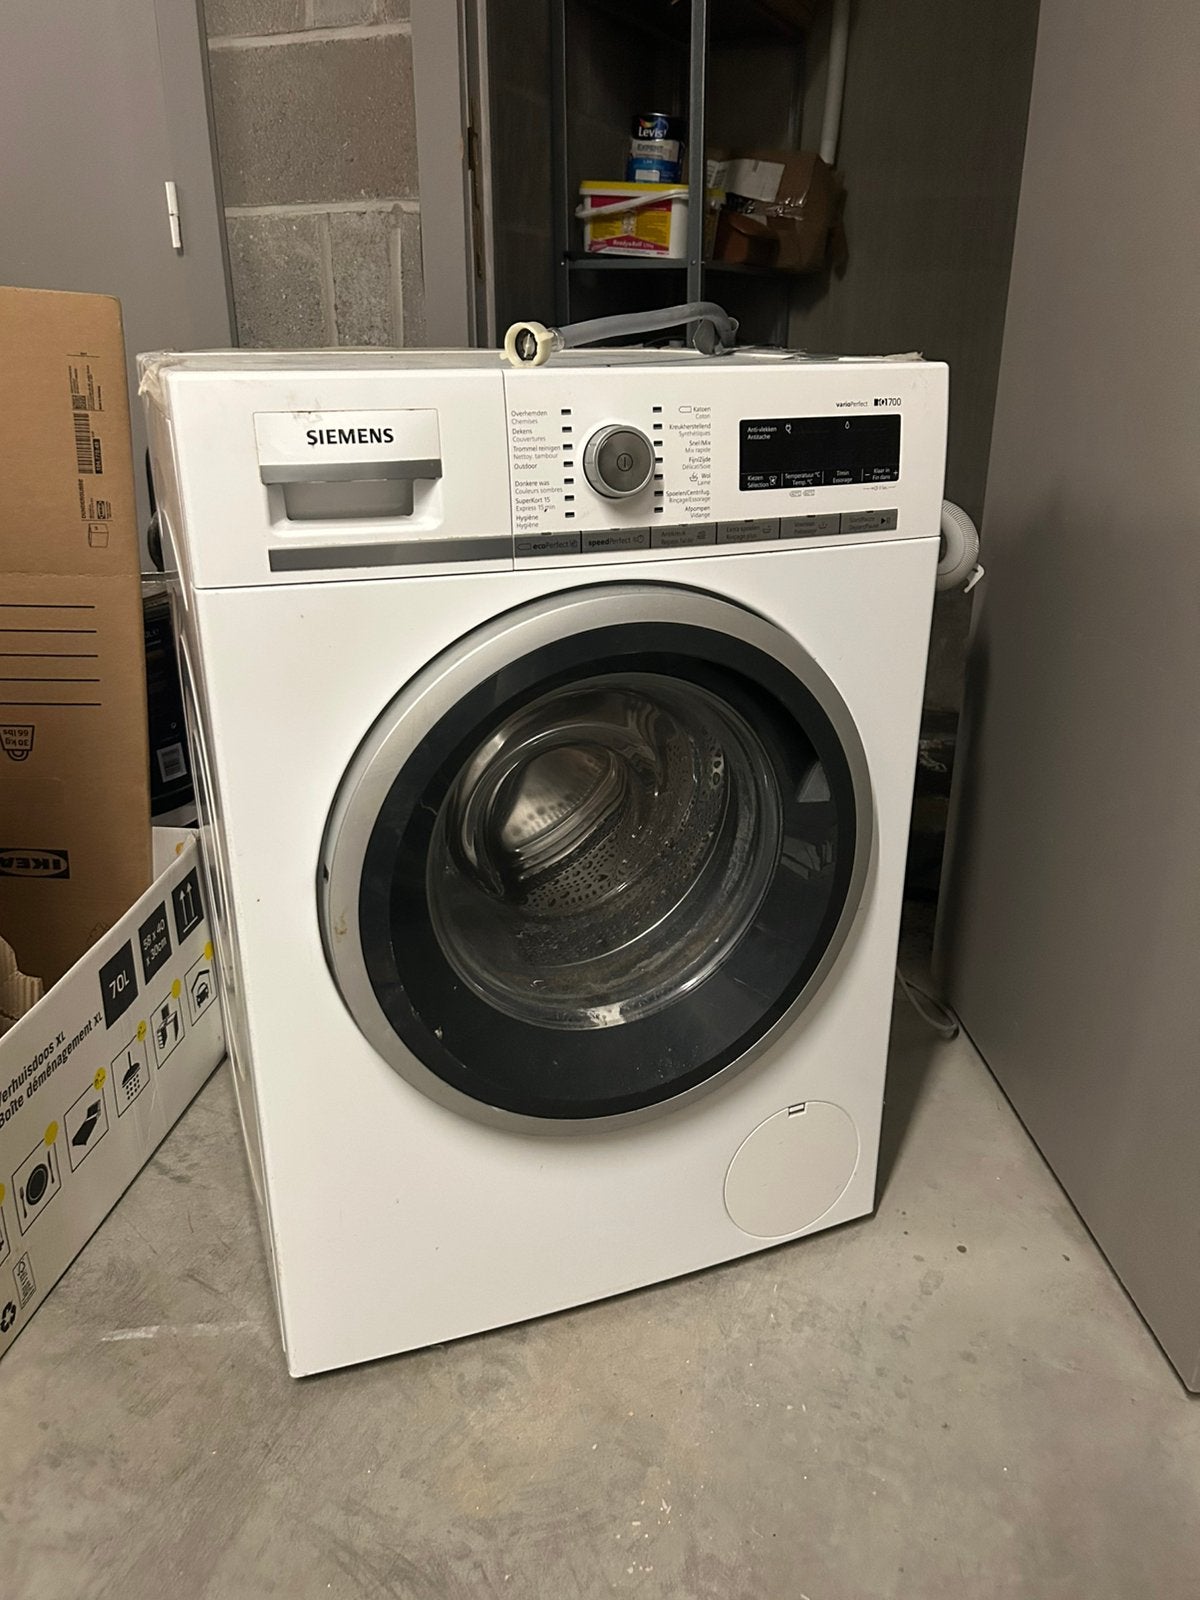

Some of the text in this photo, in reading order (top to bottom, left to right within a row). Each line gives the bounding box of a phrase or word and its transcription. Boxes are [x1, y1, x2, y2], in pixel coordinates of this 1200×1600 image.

[306, 428, 394, 445] SIEMENS
[2, 728, 29, 737] 66 lbs
[5, 736, 29, 747] 30 kg
[109, 969, 130, 999] 70L
[55, 1031, 67, 1048] XL
[26, 1017, 93, 1099] déménagement
[93, 1011, 103, 1028] XL
